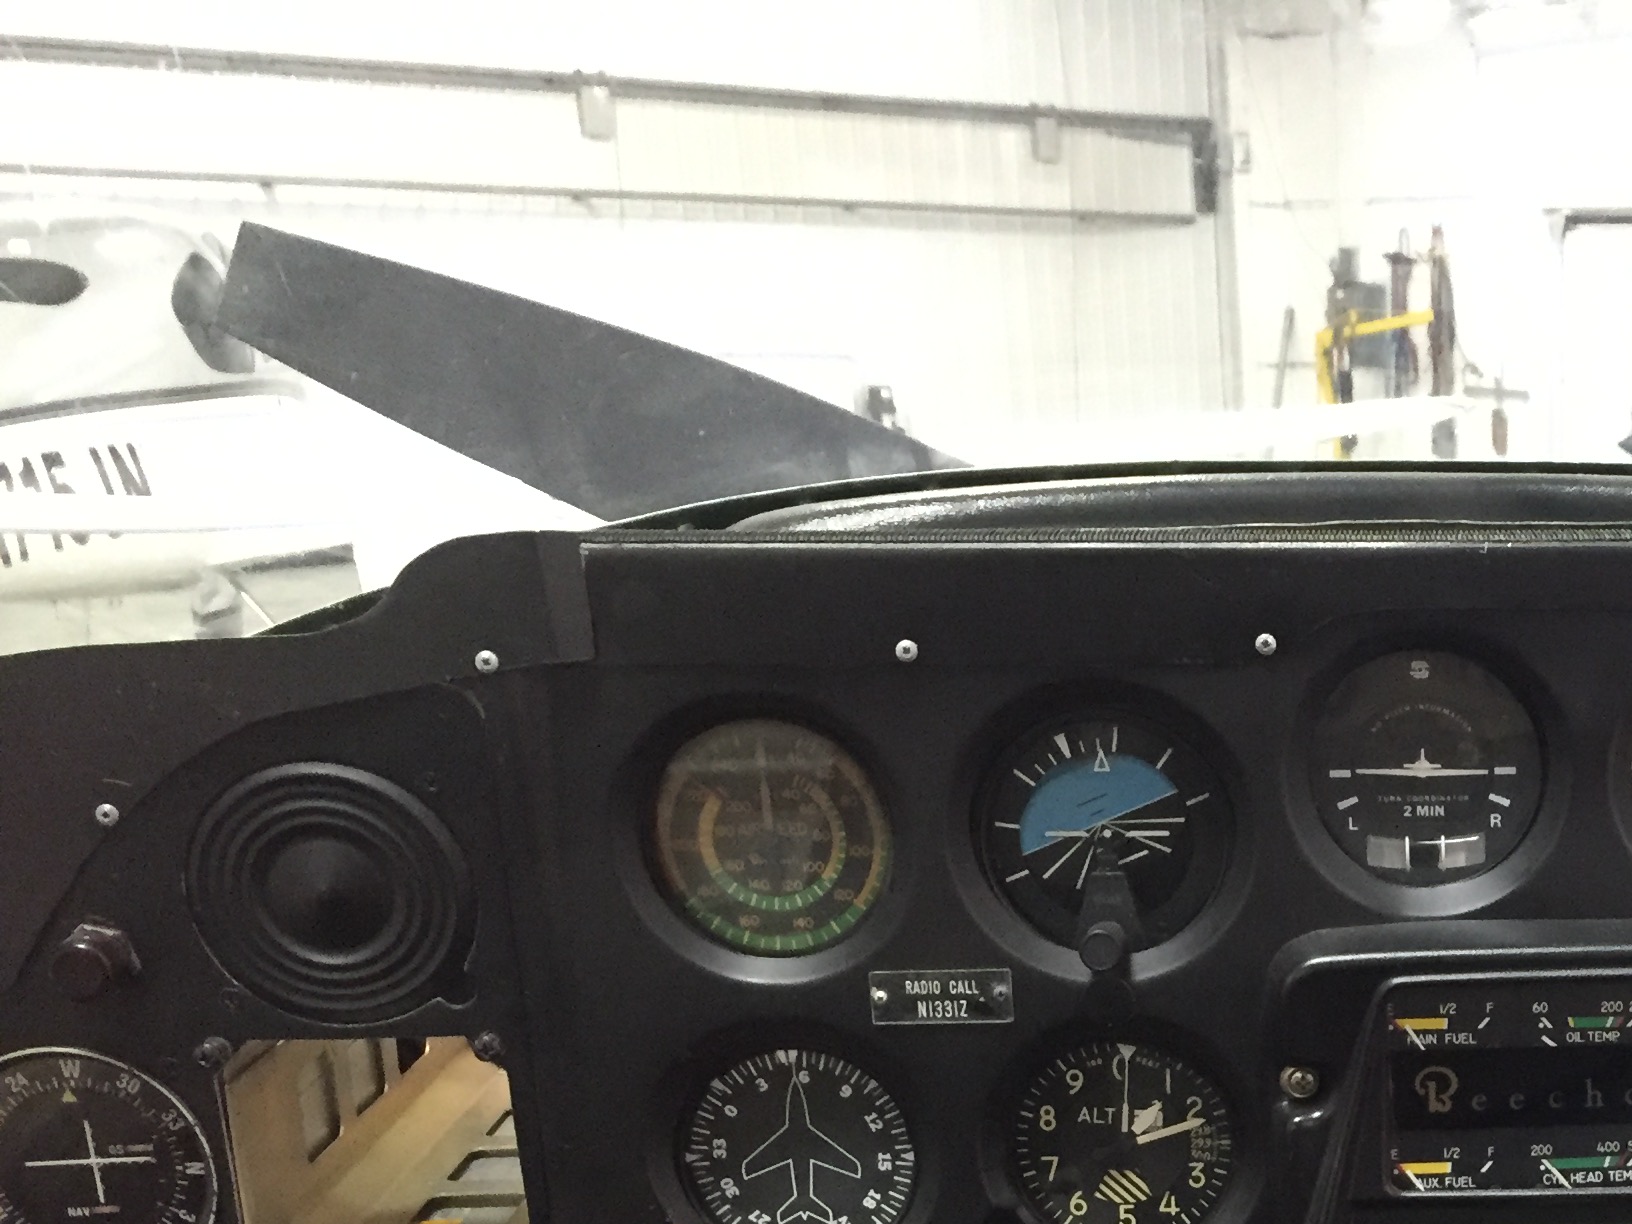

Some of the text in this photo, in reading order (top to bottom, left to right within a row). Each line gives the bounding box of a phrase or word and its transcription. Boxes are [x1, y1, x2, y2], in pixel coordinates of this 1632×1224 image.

[1416, 805, 1445, 817] MIN
[905, 980, 980, 995] RADIO CALL
[1439, 1002, 1457, 1015] 1/2
[1532, 1001, 1549, 1013] 60
[1601, 1000, 1623, 1013] 200
[1445, 1033, 1477, 1044] FUEL
[1566, 1031, 1621, 1043] OIL TEMP
[116, 1073, 140, 1094] 30
[864, 1112, 884, 1132] 12
[1077, 1106, 1116, 1125] ALT
[712, 1138, 727, 1159] 33
[1443, 1147, 1461, 1159] 1/2
[1530, 1144, 1553, 1157] 200
[1597, 1141, 1620, 1153] 400
[877, 1152, 892, 1171] 15
[1445, 1176, 1477, 1187] FUEL
[1570, 1171, 1603, 1183] HEAD
[720, 1177, 740, 1198] 30
[862, 1188, 882, 1209] 18
[67, 1207, 90, 1217] NAV
